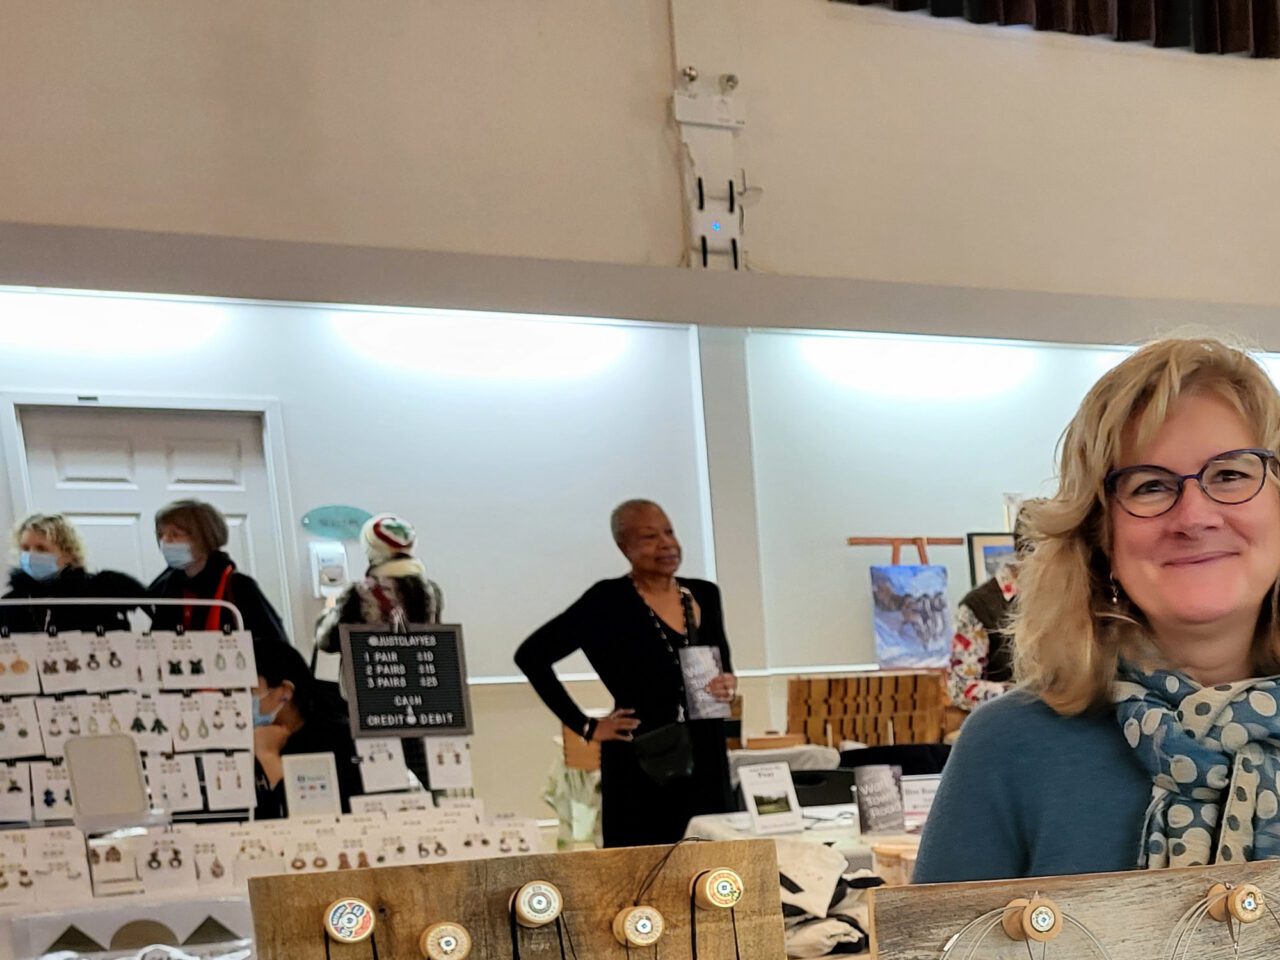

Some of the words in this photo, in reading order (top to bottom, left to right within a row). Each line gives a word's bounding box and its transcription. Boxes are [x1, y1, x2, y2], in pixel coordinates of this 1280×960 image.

[373, 651, 398, 662] PAIR
[375, 663, 406, 675] PAIRS
[377, 676, 407, 688] PAIRS
[394, 695, 422, 706] CASH
[366, 714, 404, 726] CREDIT
[420, 712, 453, 725] DEBIT
